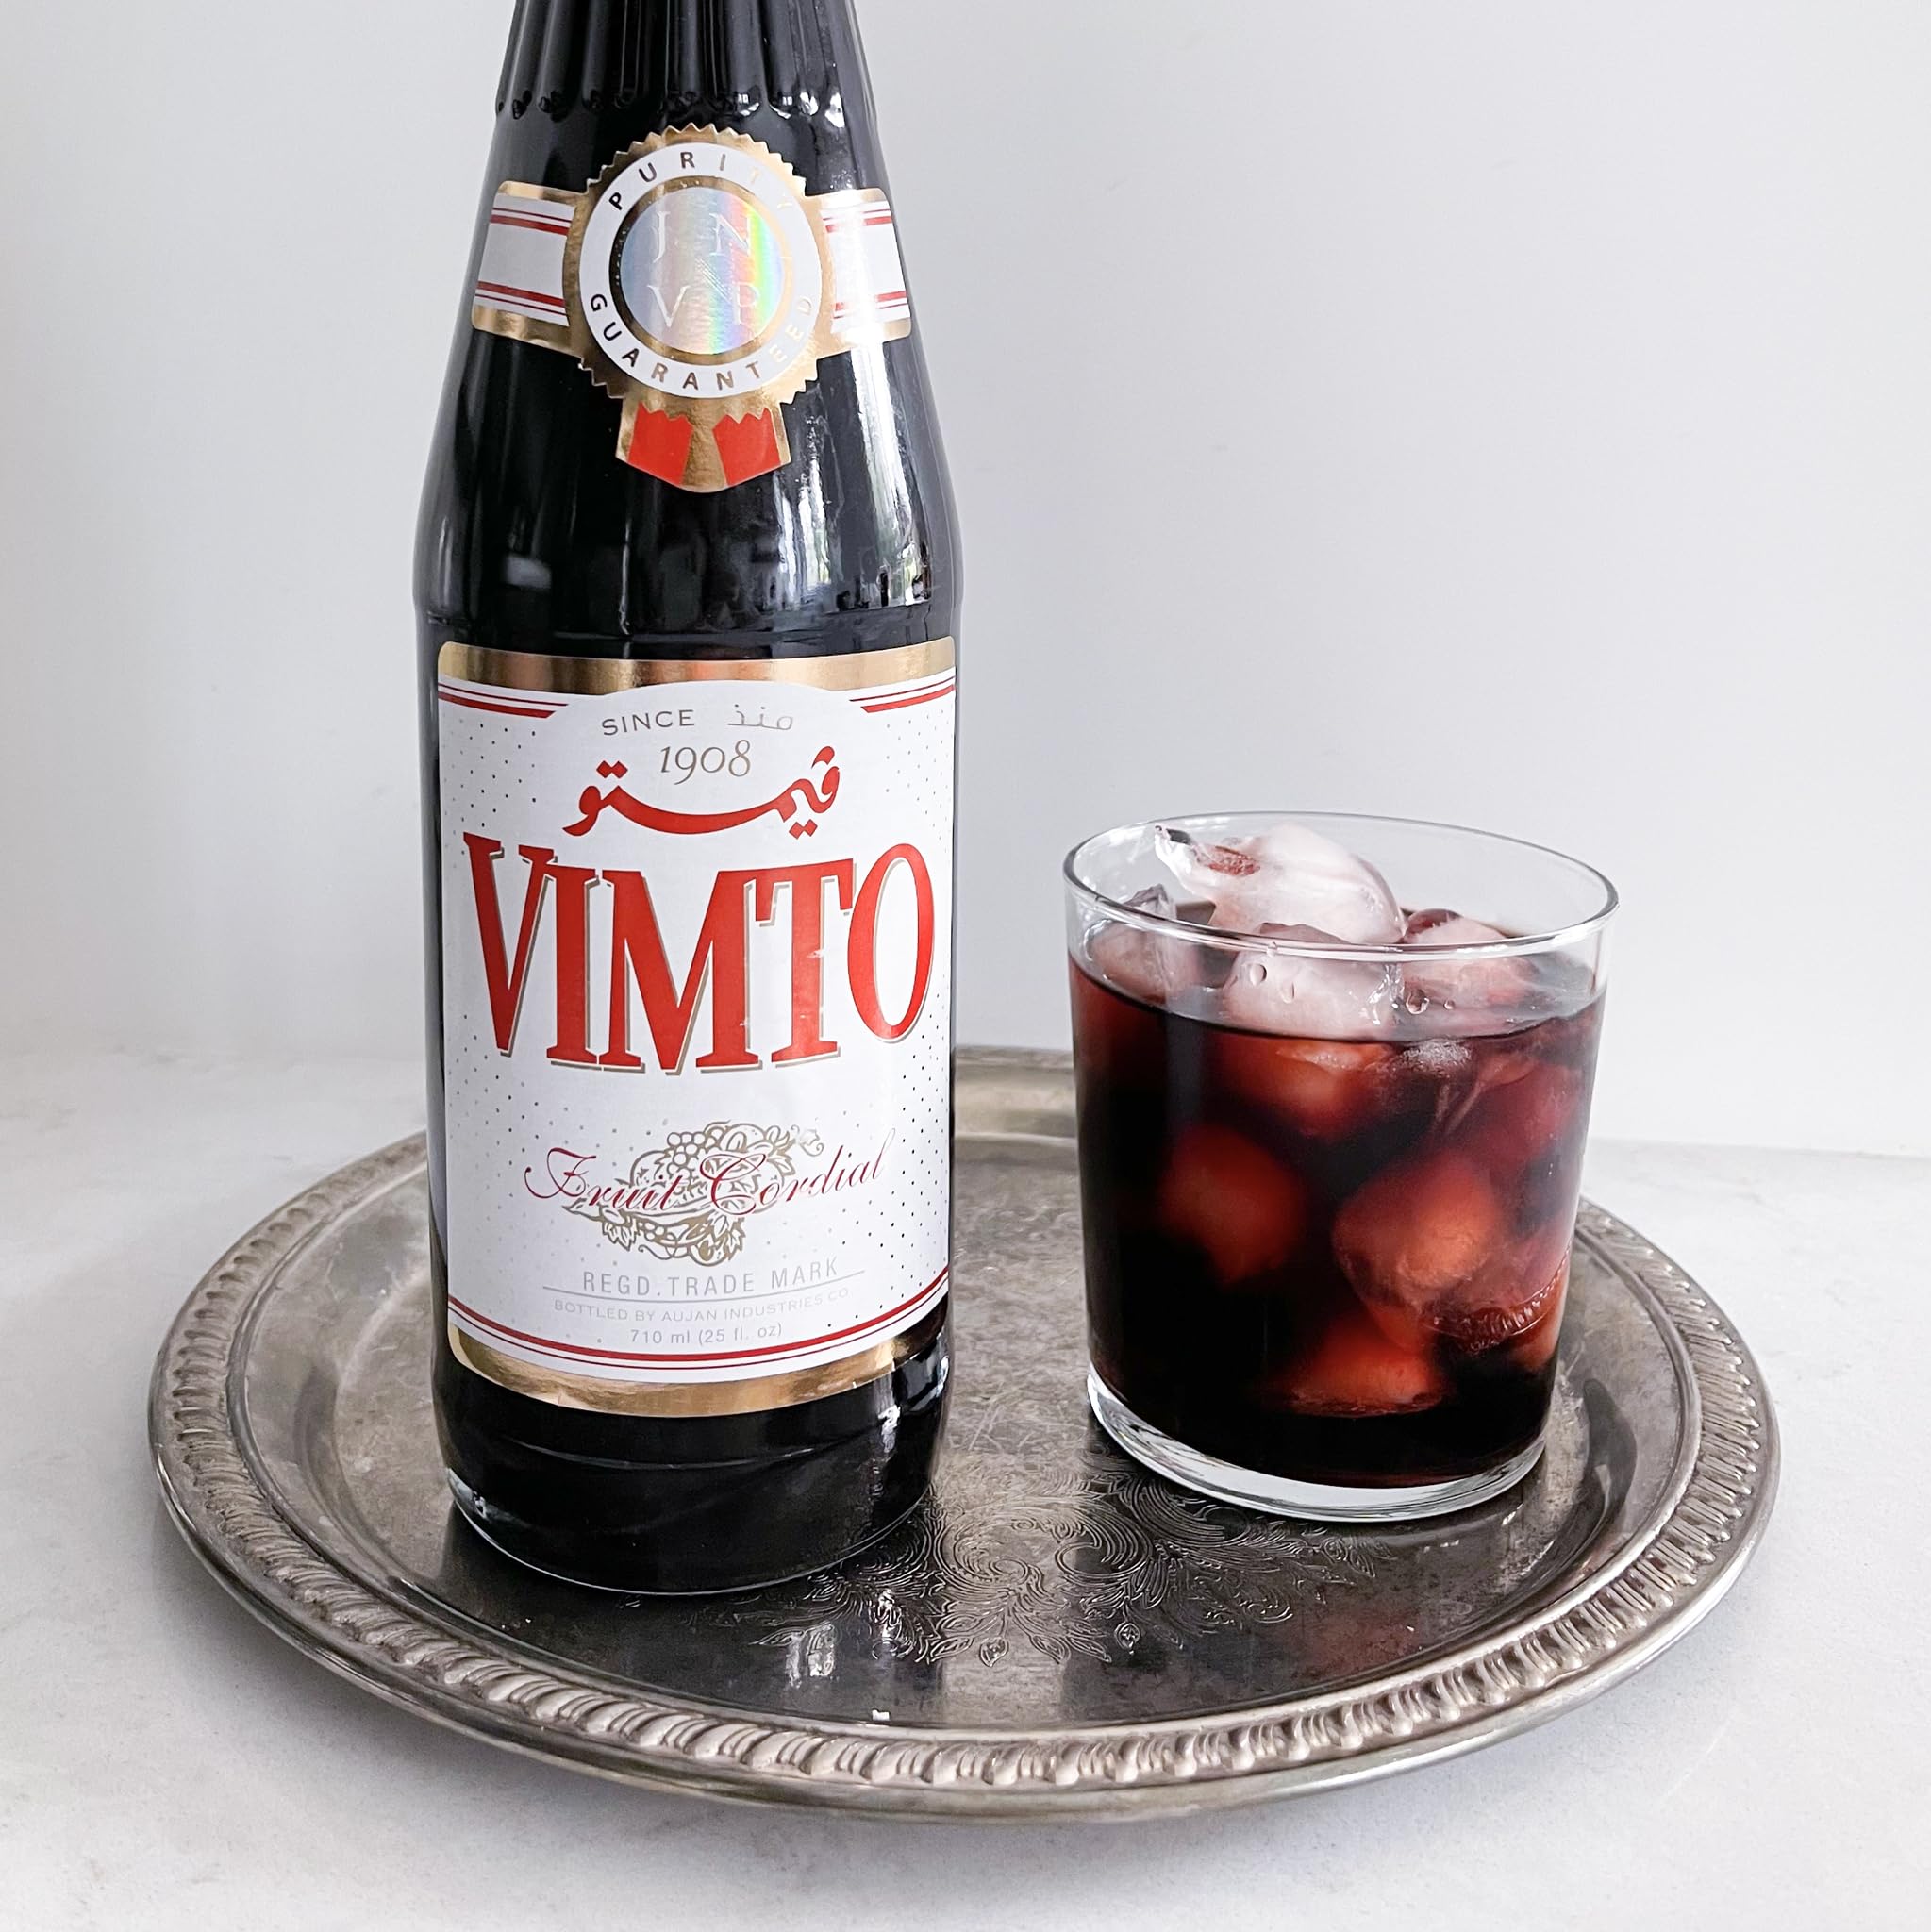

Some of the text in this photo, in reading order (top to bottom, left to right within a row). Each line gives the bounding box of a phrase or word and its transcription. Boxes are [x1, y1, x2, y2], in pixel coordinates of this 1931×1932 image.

[591, 292, 814, 391] GUARANTEED
[601, 708, 695, 736] SINCE
[727, 703, 794, 731] منذ
[660, 739, 752, 786] 1908
[463, 831, 936, 1075] VIMTO
[524, 1127, 896, 1215] Fruit Cordial
[771, 1259, 839, 1290] MARK
[554, 1298, 628, 1321] BOTTLED
[635, 1309, 654, 1322] BY
[661, 1309, 718, 1322] AUJAN
[724, 1294, 823, 1320] INDUSTRIES
[630, 1323, 782, 1346] 710 ml (25 fl. oz)
